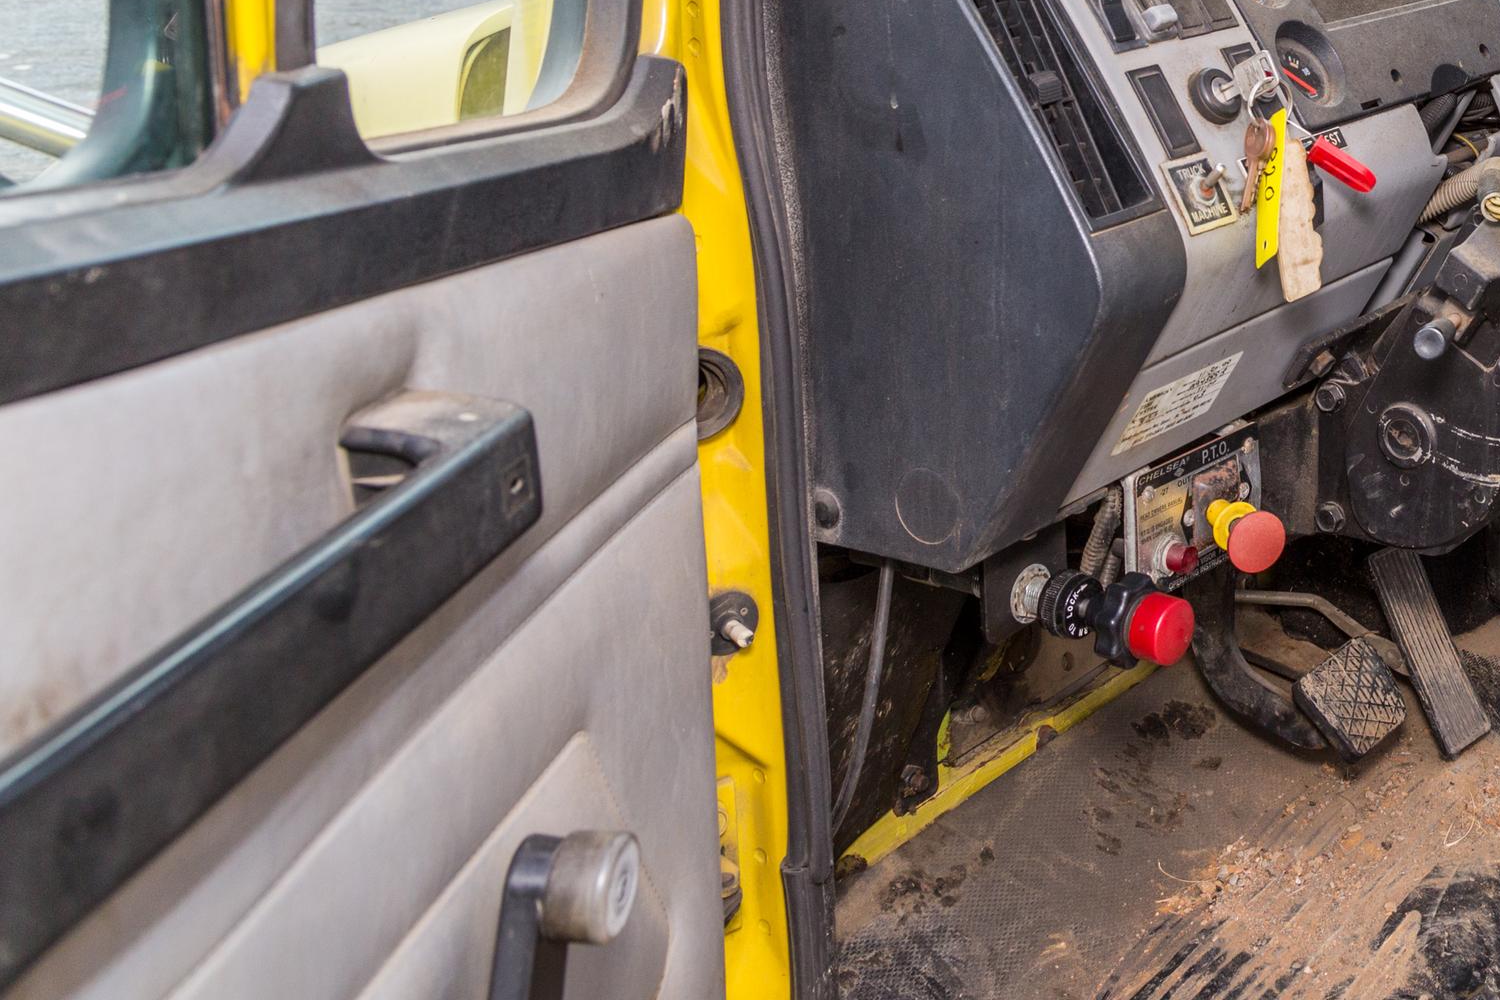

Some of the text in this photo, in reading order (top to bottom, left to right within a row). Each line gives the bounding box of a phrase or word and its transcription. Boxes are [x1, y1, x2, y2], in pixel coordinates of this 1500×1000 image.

[1176, 162, 1207, 180] TRUCK
[1191, 202, 1229, 223] MACHINE
[1138, 440, 1230, 486] CHELSEA P.T.O.
[1066, 592, 1079, 619] LOCK
[1068, 623, 1076, 635] TO
